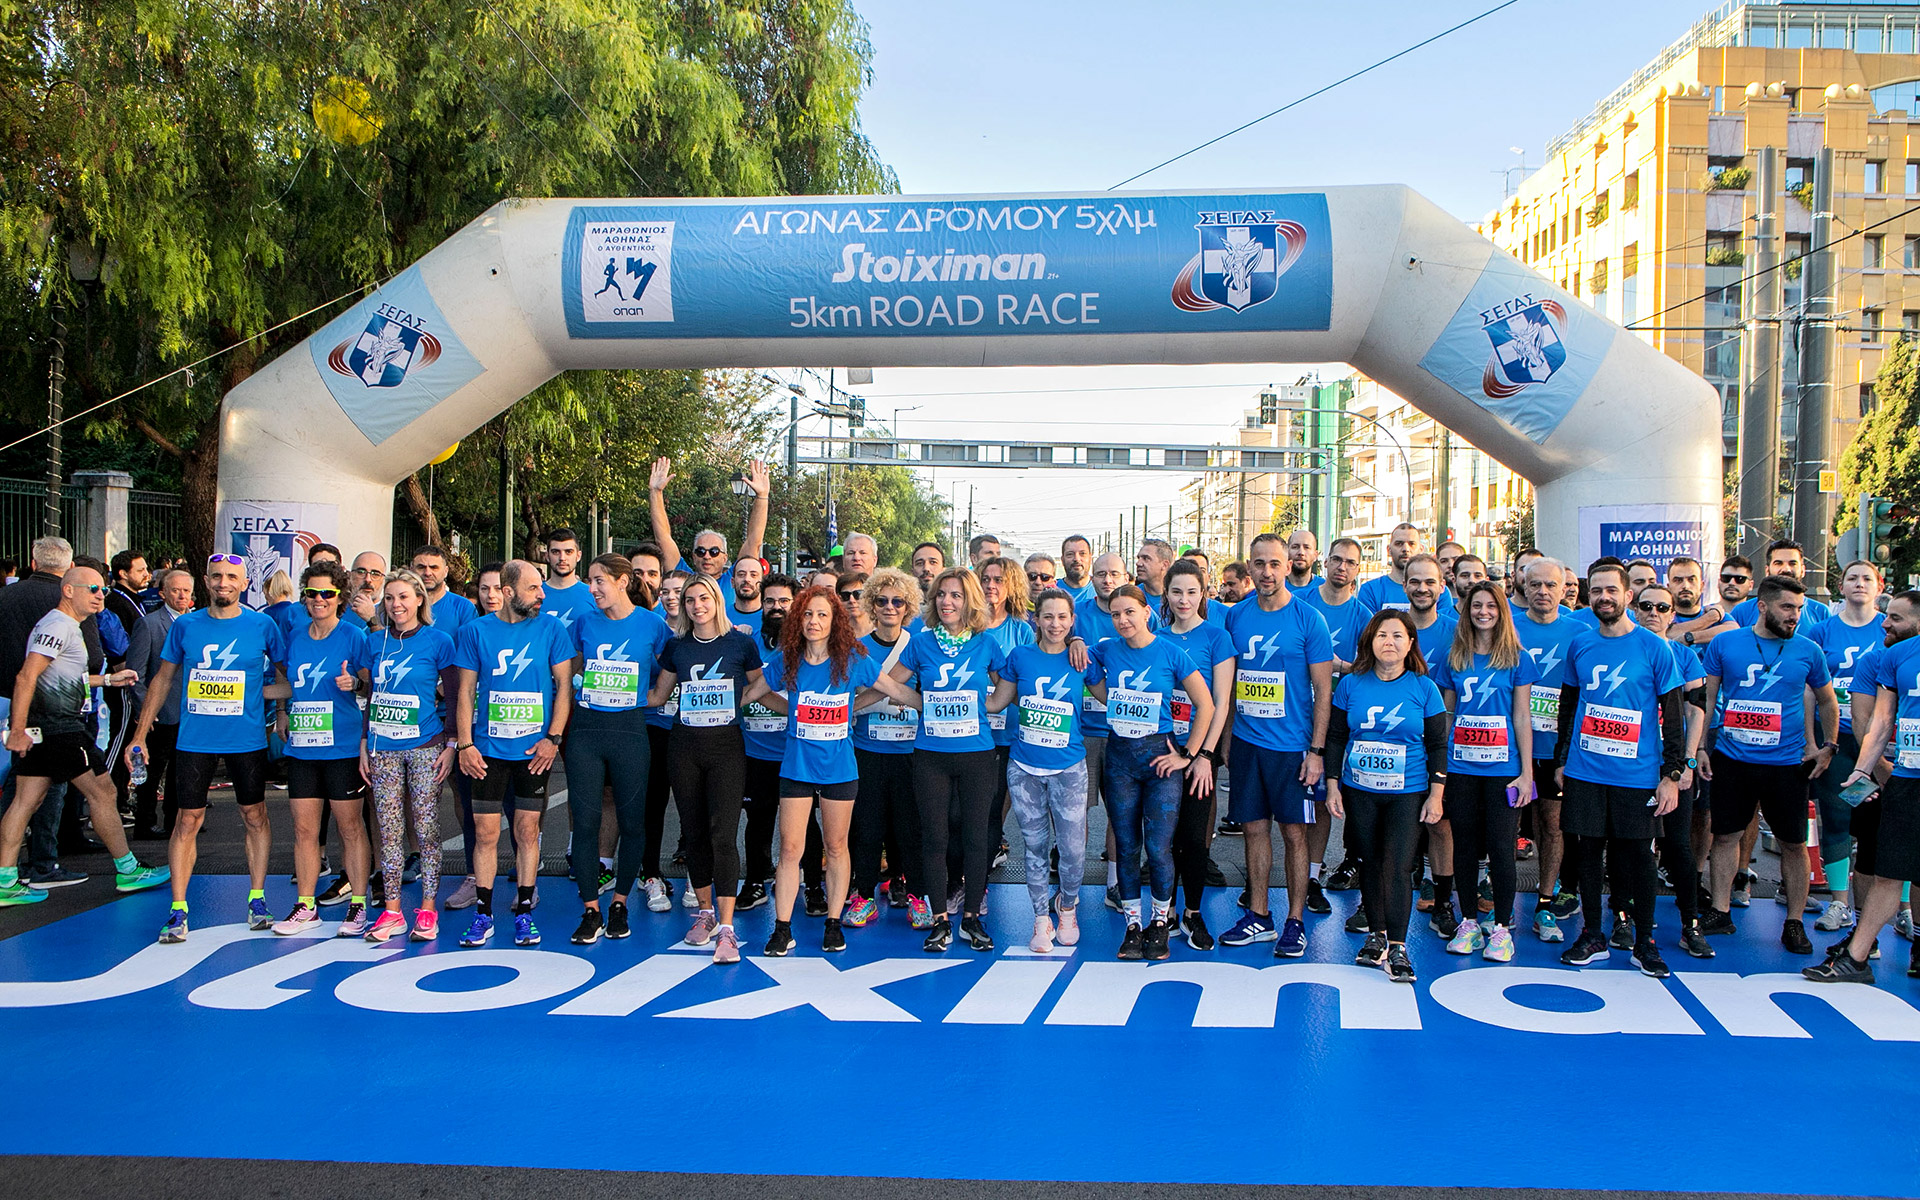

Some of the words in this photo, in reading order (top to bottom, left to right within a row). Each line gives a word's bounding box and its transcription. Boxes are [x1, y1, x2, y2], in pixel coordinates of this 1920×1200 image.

[733, 209, 890, 235] ΑΓΩΝΑΣ
[895, 207, 1063, 233] ΔΡΟΜΟΥ
[1075, 205, 1157, 235] 5χλμ
[1198, 210, 1276, 225] ΣΕΓΑΣ
[591, 226, 667, 234] ΜΑΡΑΘΩΝΙΟΣ
[604, 235, 651, 244] ΑΘΗΝΑΣ
[832, 243, 1046, 284] Stoiximan
[789, 296, 862, 328] 5km
[870, 295, 984, 327] ROAD
[997, 292, 1099, 325] RACE
[1479, 293, 1538, 325] ΣΕΓΑΣ
[376, 302, 427, 332] ΣΕΓΑΣ
[1823, 476, 1833, 487] 50
[232, 517, 295, 532] ΣΕΓΑΣ
[1630, 543, 1691, 556] ΑΘΗΝΑΣ
[588, 662, 632, 674] Stoiximan
[193, 672, 239, 682] Stoiximan
[593, 673, 628, 688] 51878
[1239, 672, 1279, 684] Stoiximan
[199, 683, 234, 696] 50044
[685, 682, 727, 693] Stoiximan
[1244, 684, 1275, 698] 50124
[492, 694, 537, 704] Stoiximan
[691, 693, 724, 706] 61481
[802, 695, 845, 707] Stoiximan
[928, 694, 971, 703] Stoiximan
[1111, 690, 1155, 704] Stoiximan
[499, 706, 534, 719] 51733
[935, 704, 969, 718] 61419
[1023, 698, 1067, 714] Stoiximan
[1115, 702, 1150, 718] 61402
[1731, 702, 1775, 713] Stoiximan
[378, 706, 409, 721] 59709
[808, 708, 842, 721] 53714
[1026, 709, 1062, 728] 59750
[1589, 707, 1634, 722] Stoiximan
[1735, 712, 1771, 727] 53585
[293, 715, 323, 727] 51876
[1458, 717, 1500, 728] Stoiximan
[1592, 719, 1629, 737] 53589
[1463, 729, 1498, 742] 53717
[1356, 744, 1399, 755] Stoiximan
[1359, 755, 1395, 770] 61363
[0, 920, 1920, 1042] Stoiximan
